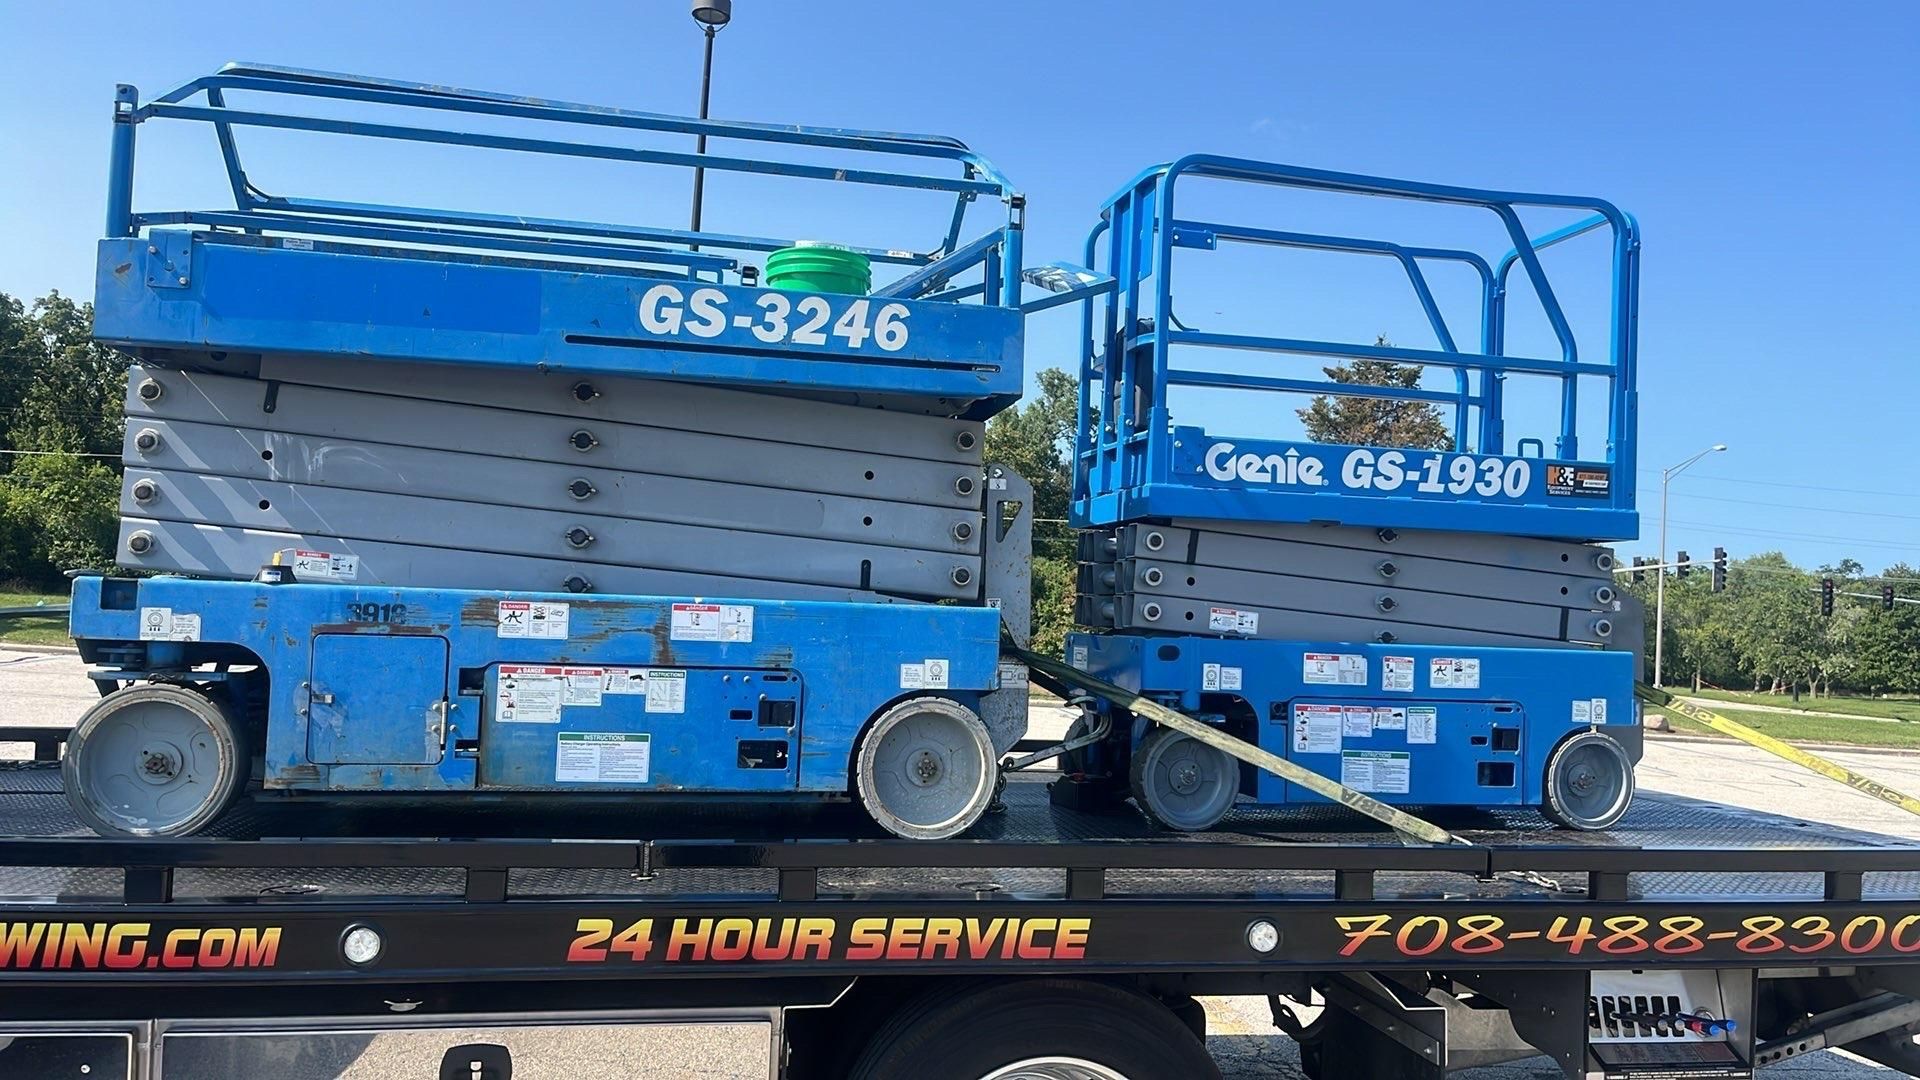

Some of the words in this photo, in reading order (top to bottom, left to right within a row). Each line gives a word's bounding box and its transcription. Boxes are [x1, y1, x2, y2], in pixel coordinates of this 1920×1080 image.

[639, 284, 911, 352] GS-3246
[1204, 442, 1324, 486] Genie
[1341, 449, 1531, 498] GS-1930
[566, 918, 653, 962] 24
[665, 918, 836, 961] HOUR
[846, 917, 1091, 960] SERVICE
[1334, 913, 1920, 957] 708-488-8300
